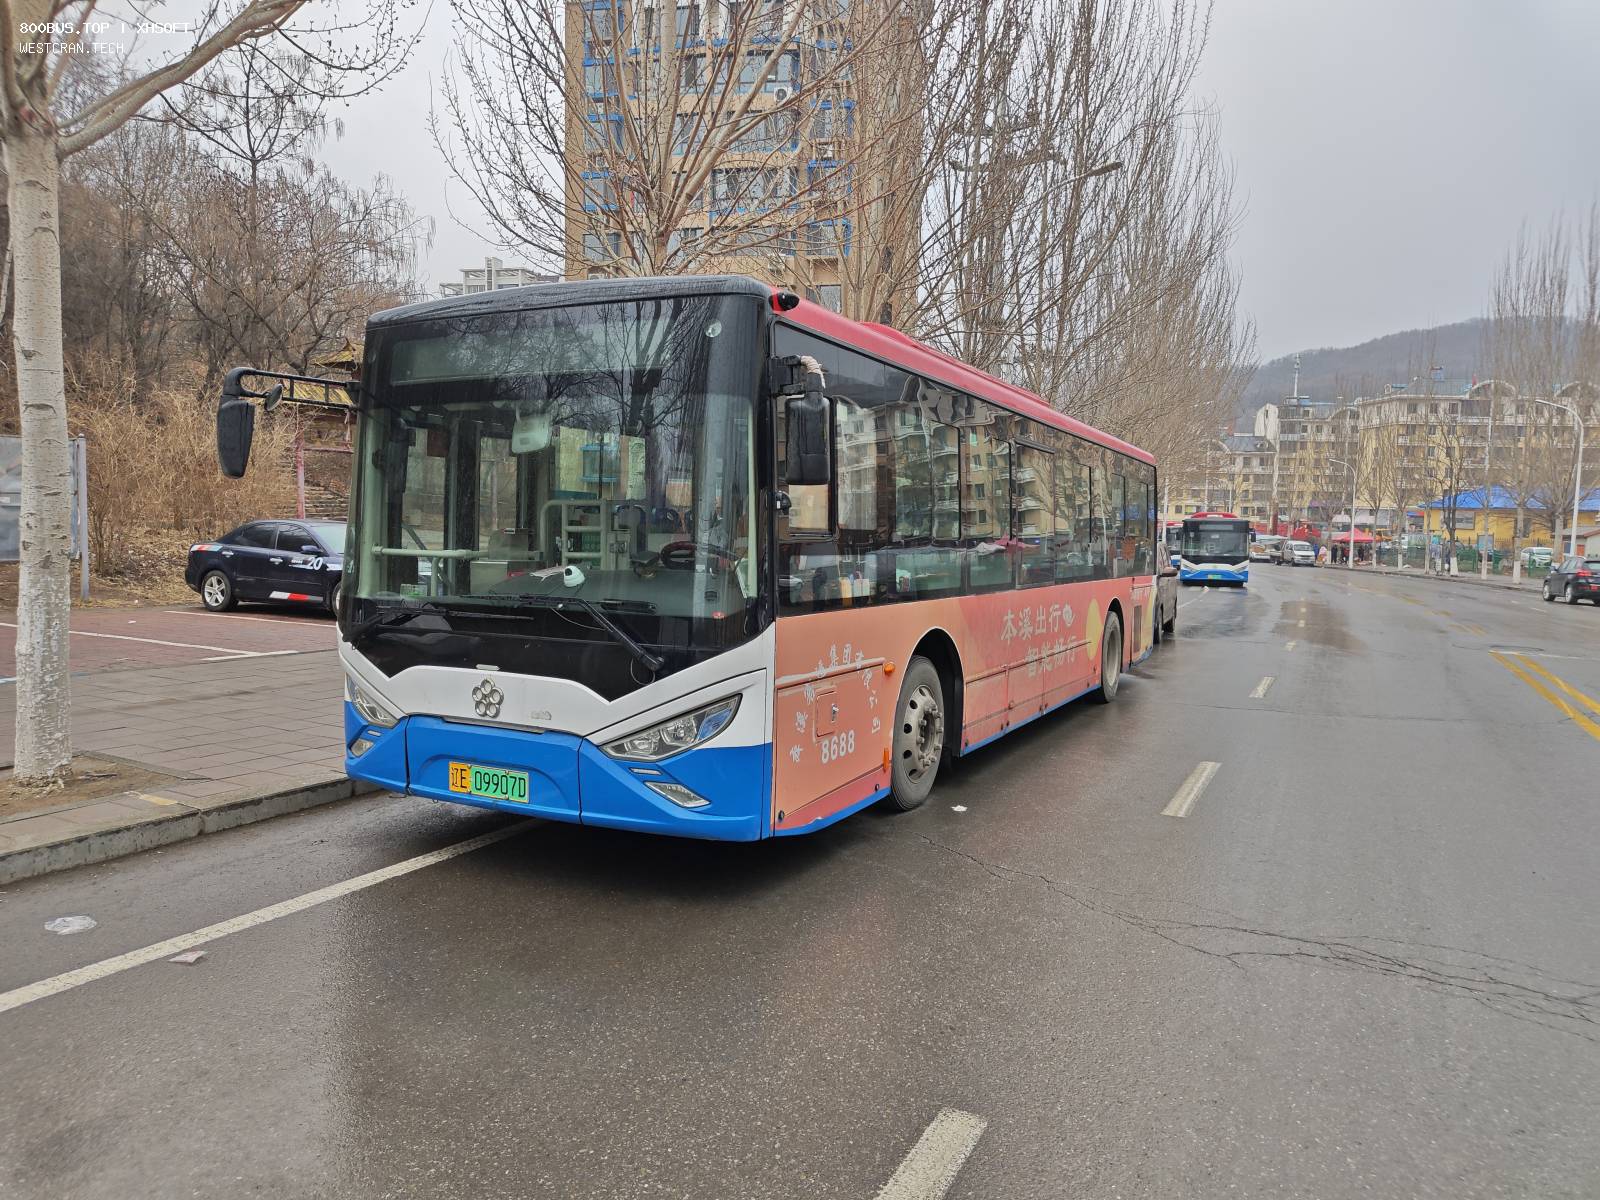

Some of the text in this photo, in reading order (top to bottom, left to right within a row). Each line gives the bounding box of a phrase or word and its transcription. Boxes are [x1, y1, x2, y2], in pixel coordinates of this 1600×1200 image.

[1000, 602, 1062, 645] 本溪出行
[821, 730, 855, 765] 8688
